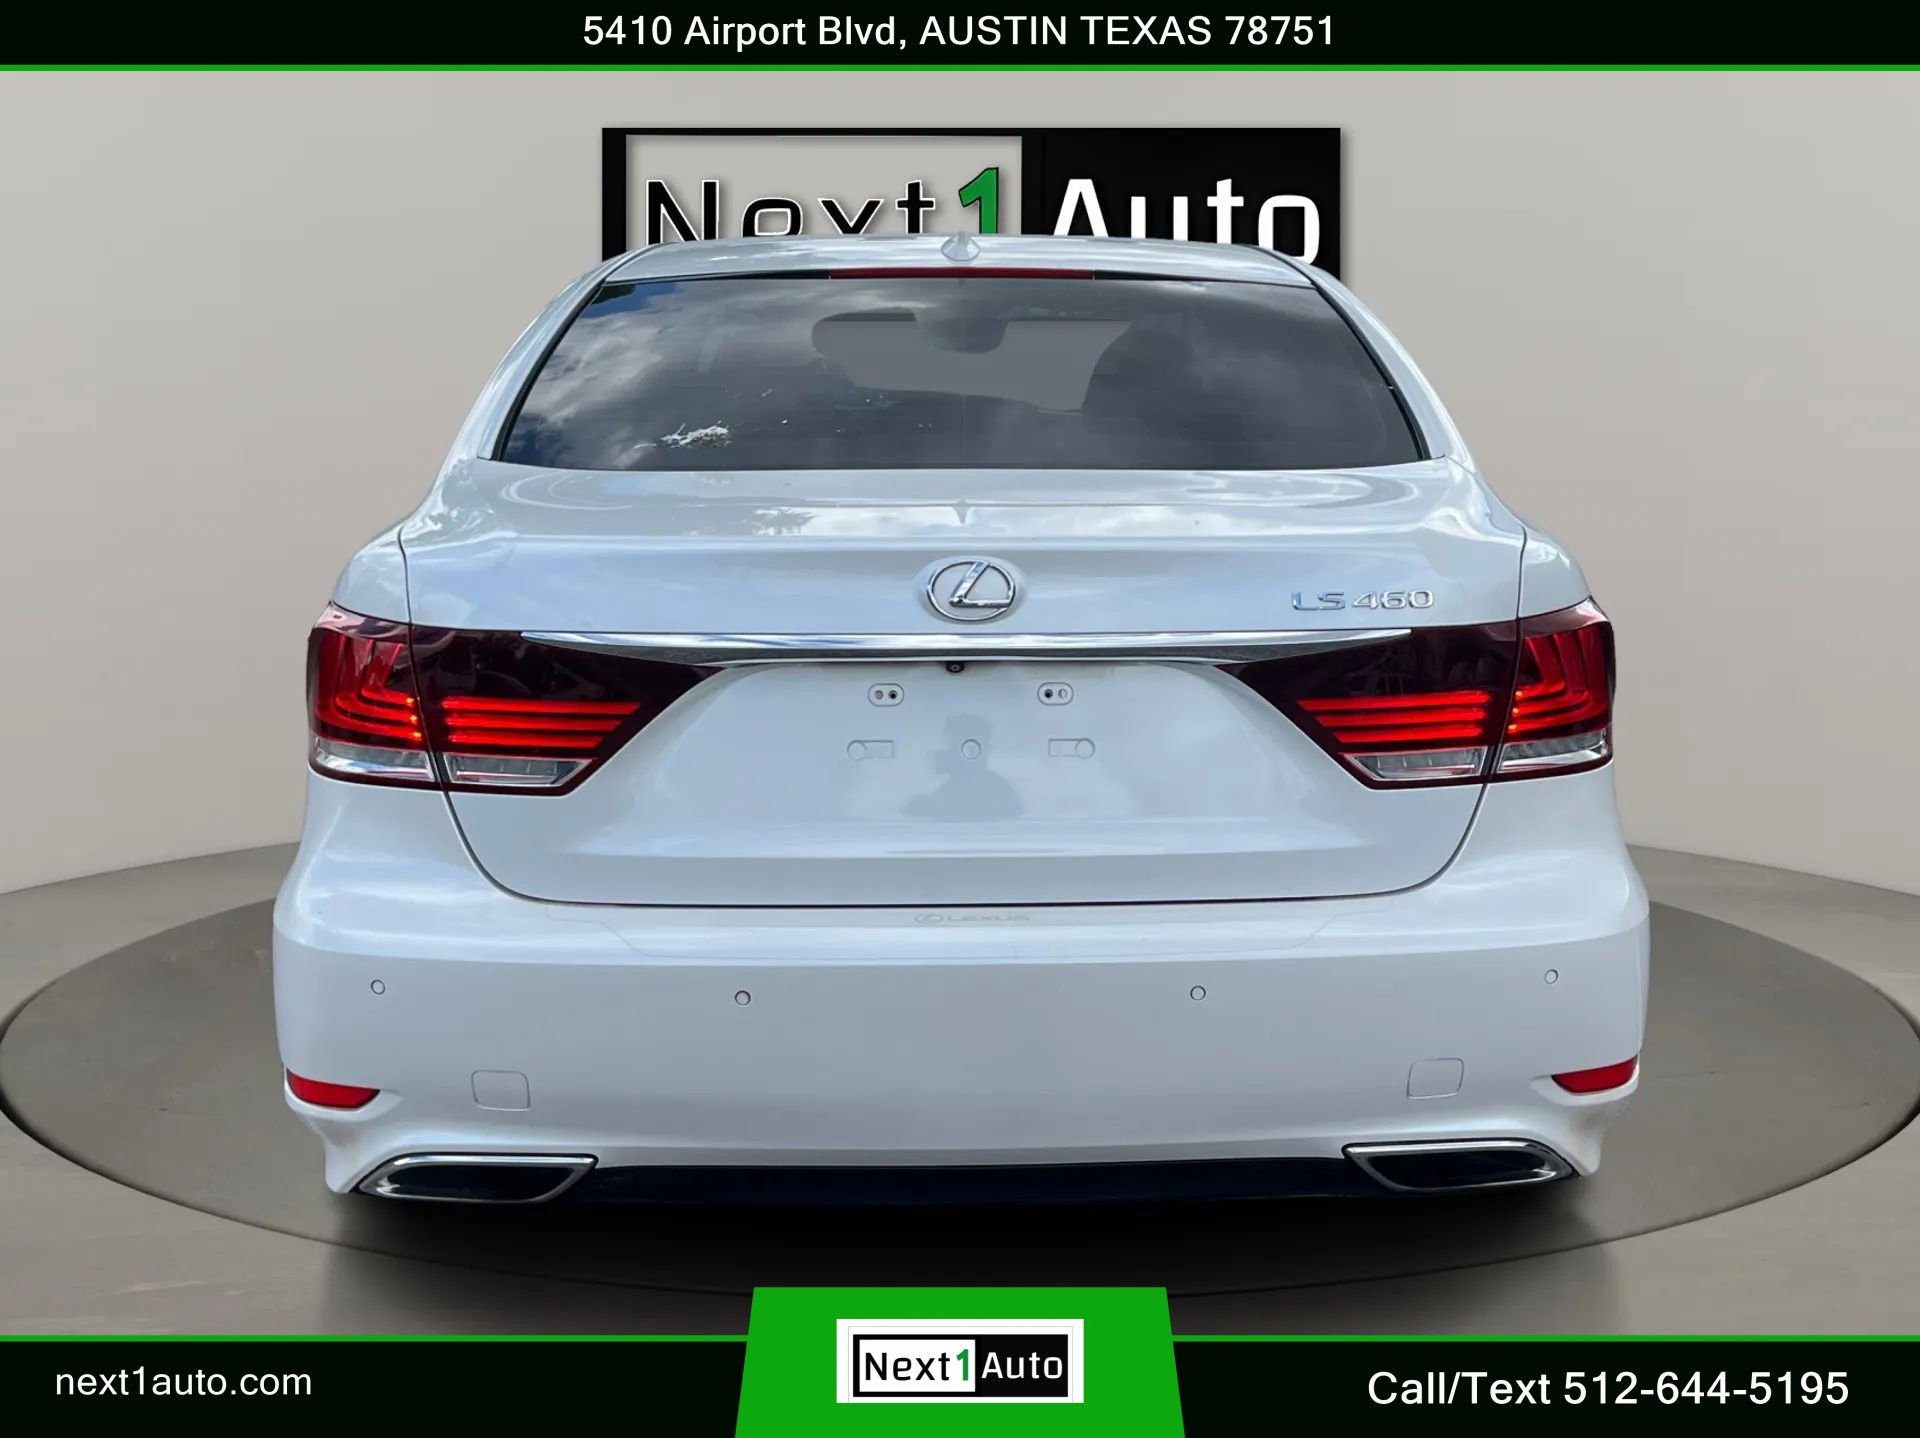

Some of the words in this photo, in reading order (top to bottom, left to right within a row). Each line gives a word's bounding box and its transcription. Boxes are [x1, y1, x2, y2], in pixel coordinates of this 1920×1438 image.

[1053, 178, 1320, 265] Auto
[1292, 592, 1346, 611] LS
[1352, 589, 1434, 609] 460
